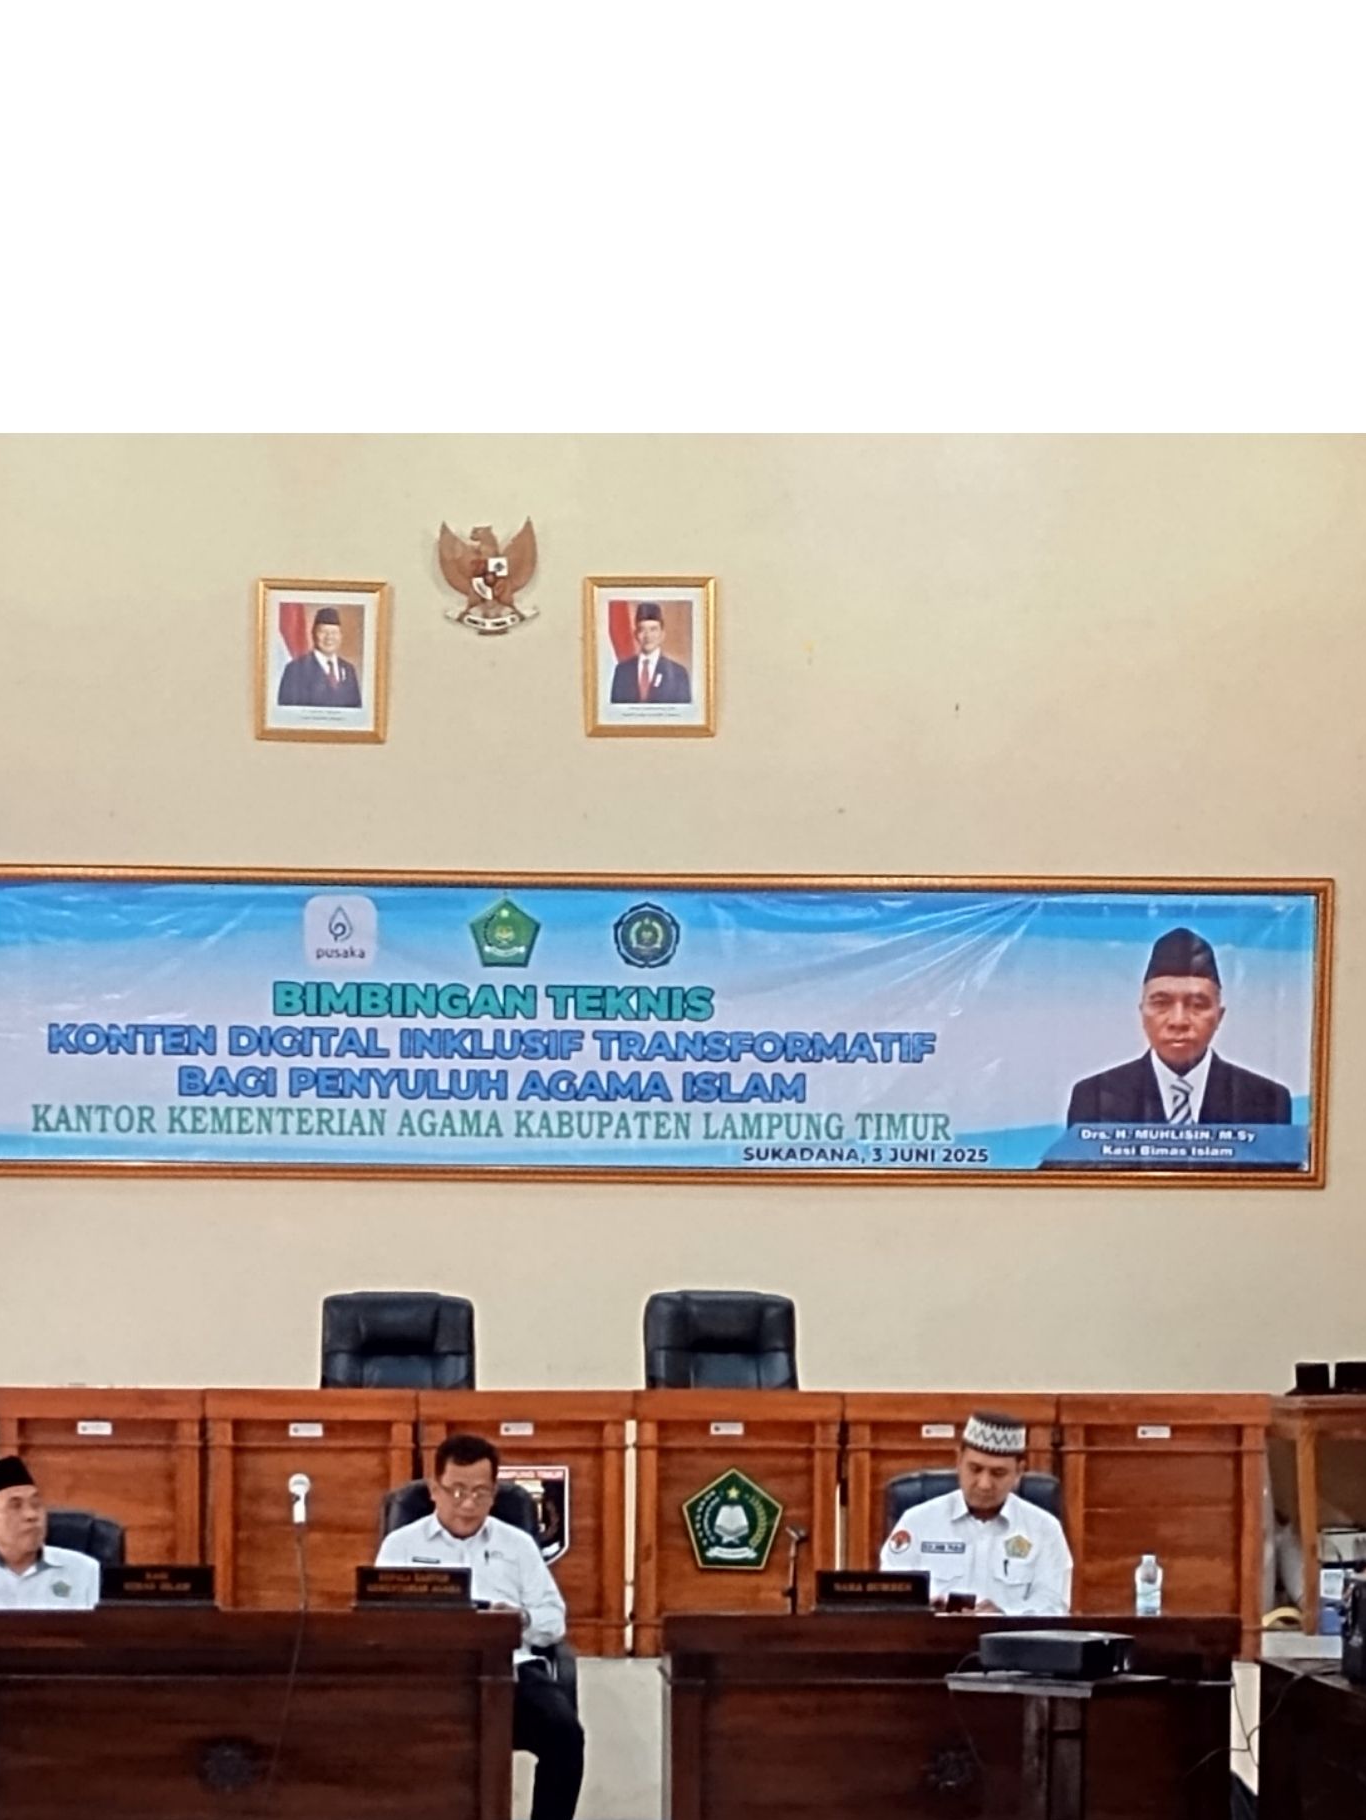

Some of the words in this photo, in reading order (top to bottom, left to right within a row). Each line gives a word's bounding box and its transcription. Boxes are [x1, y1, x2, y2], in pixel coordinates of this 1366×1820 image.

[316, 946, 366, 960] pusaka
[273, 981, 536, 1020] BIMBINGAN
[546, 985, 715, 1021] TEKNIS
[47, 1023, 217, 1056] KONTEN
[228, 1025, 390, 1058] DIGITAL
[400, 1027, 584, 1060] INKLUSIF
[593, 1030, 936, 1063] TRANSFORMATIF
[178, 1065, 277, 1098] BAGI
[288, 1067, 508, 1100] PENYULUH
[517, 1070, 673, 1102] AGAMA
[682, 1072, 807, 1104] ISLAM
[31, 1104, 156, 1134] KANTOR
[166, 1106, 385, 1137] KEMENTERIAN
[397, 1108, 503, 1138] AGAMA
[515, 1110, 691, 1140] KABUPATEN
[703, 1111, 844, 1142] LAMPUNG
[855, 1113, 951, 1142] TIMUR
[742, 1147, 866, 1165] SUKADANA,
[872, 1149, 883, 1163] 3
[888, 1148, 936, 1163] JUNI
[942, 1148, 988, 1163] 2025
[1102, 1145, 1135, 1156] Kasi
[1140, 1145, 1187, 1156] Bimas
[1191, 1145, 1233, 1156] Islam
